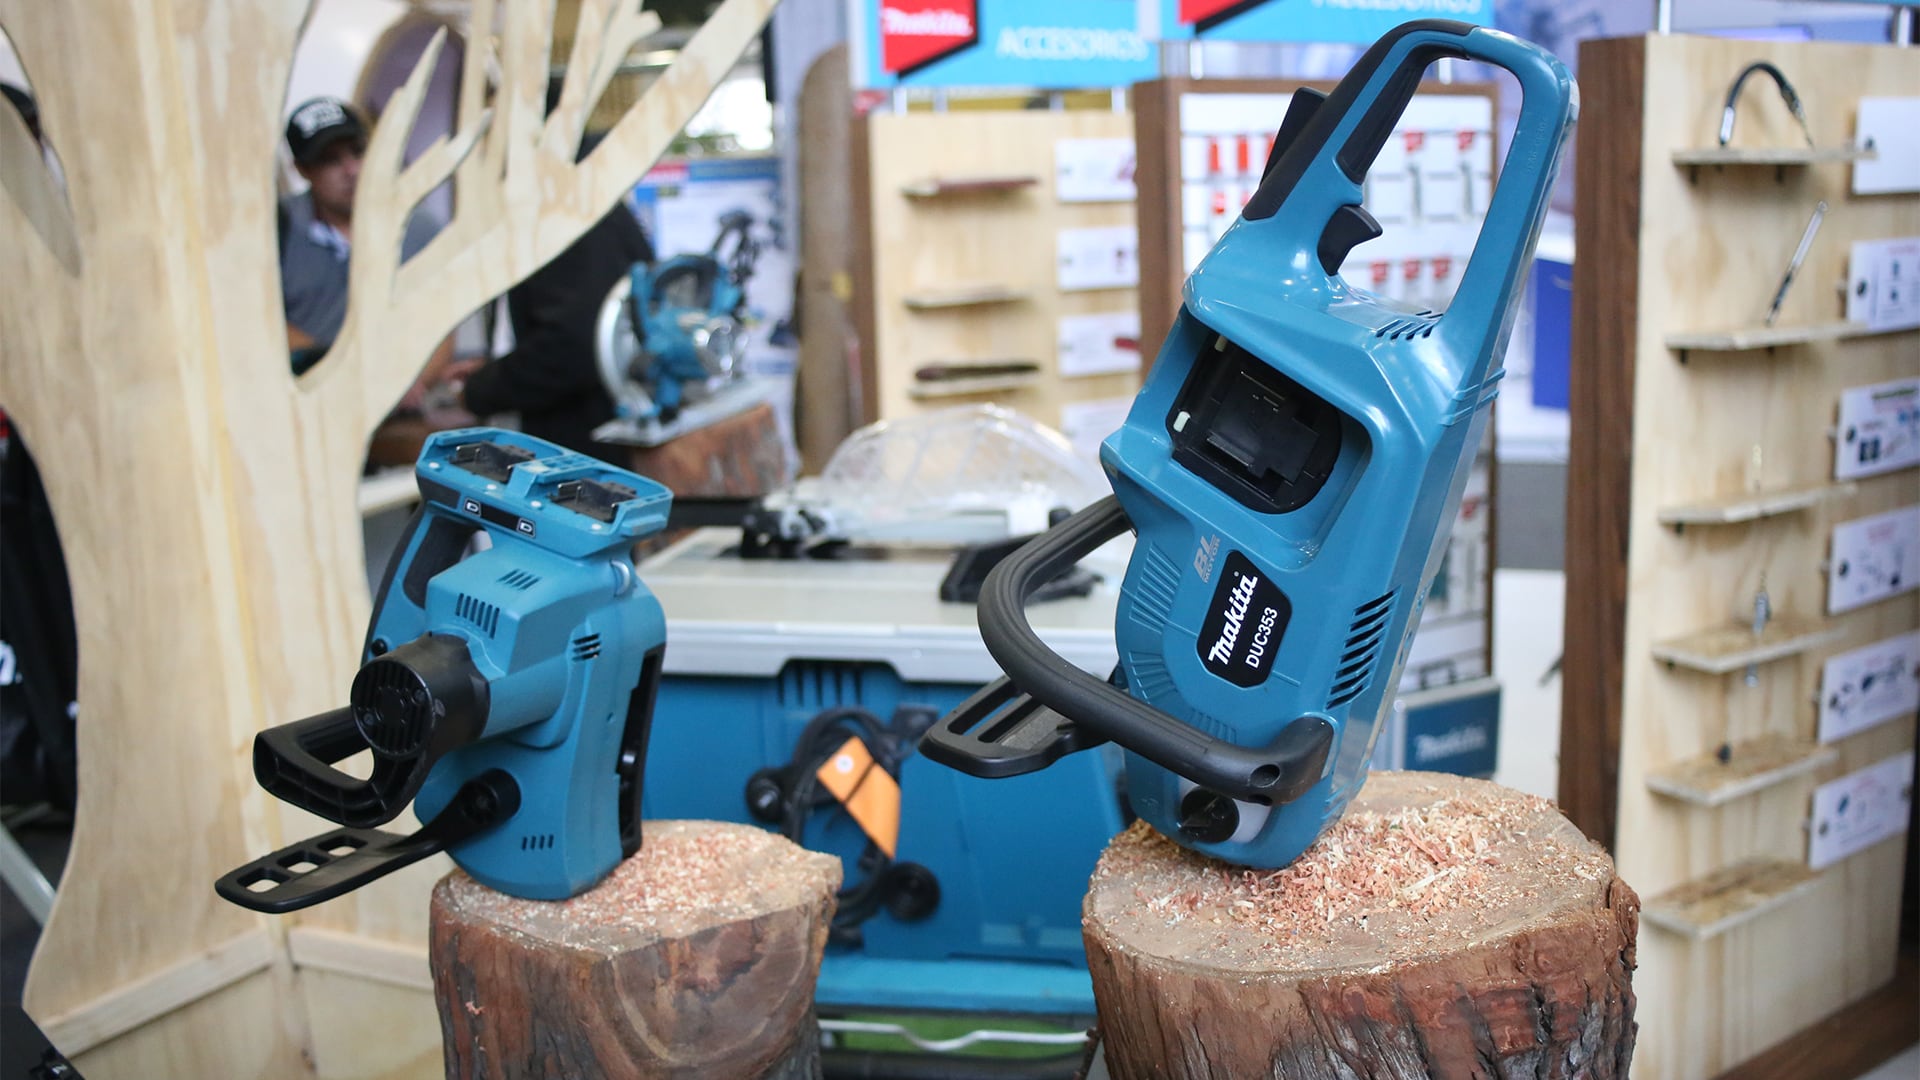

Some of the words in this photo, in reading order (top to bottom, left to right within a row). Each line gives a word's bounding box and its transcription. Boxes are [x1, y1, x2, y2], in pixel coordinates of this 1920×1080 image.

[1193, 534, 1216, 579] BL
[1203, 537, 1221, 584] MOTOR
[1208, 574, 1258, 665] Makita
[1245, 607, 1278, 668] DUC353
